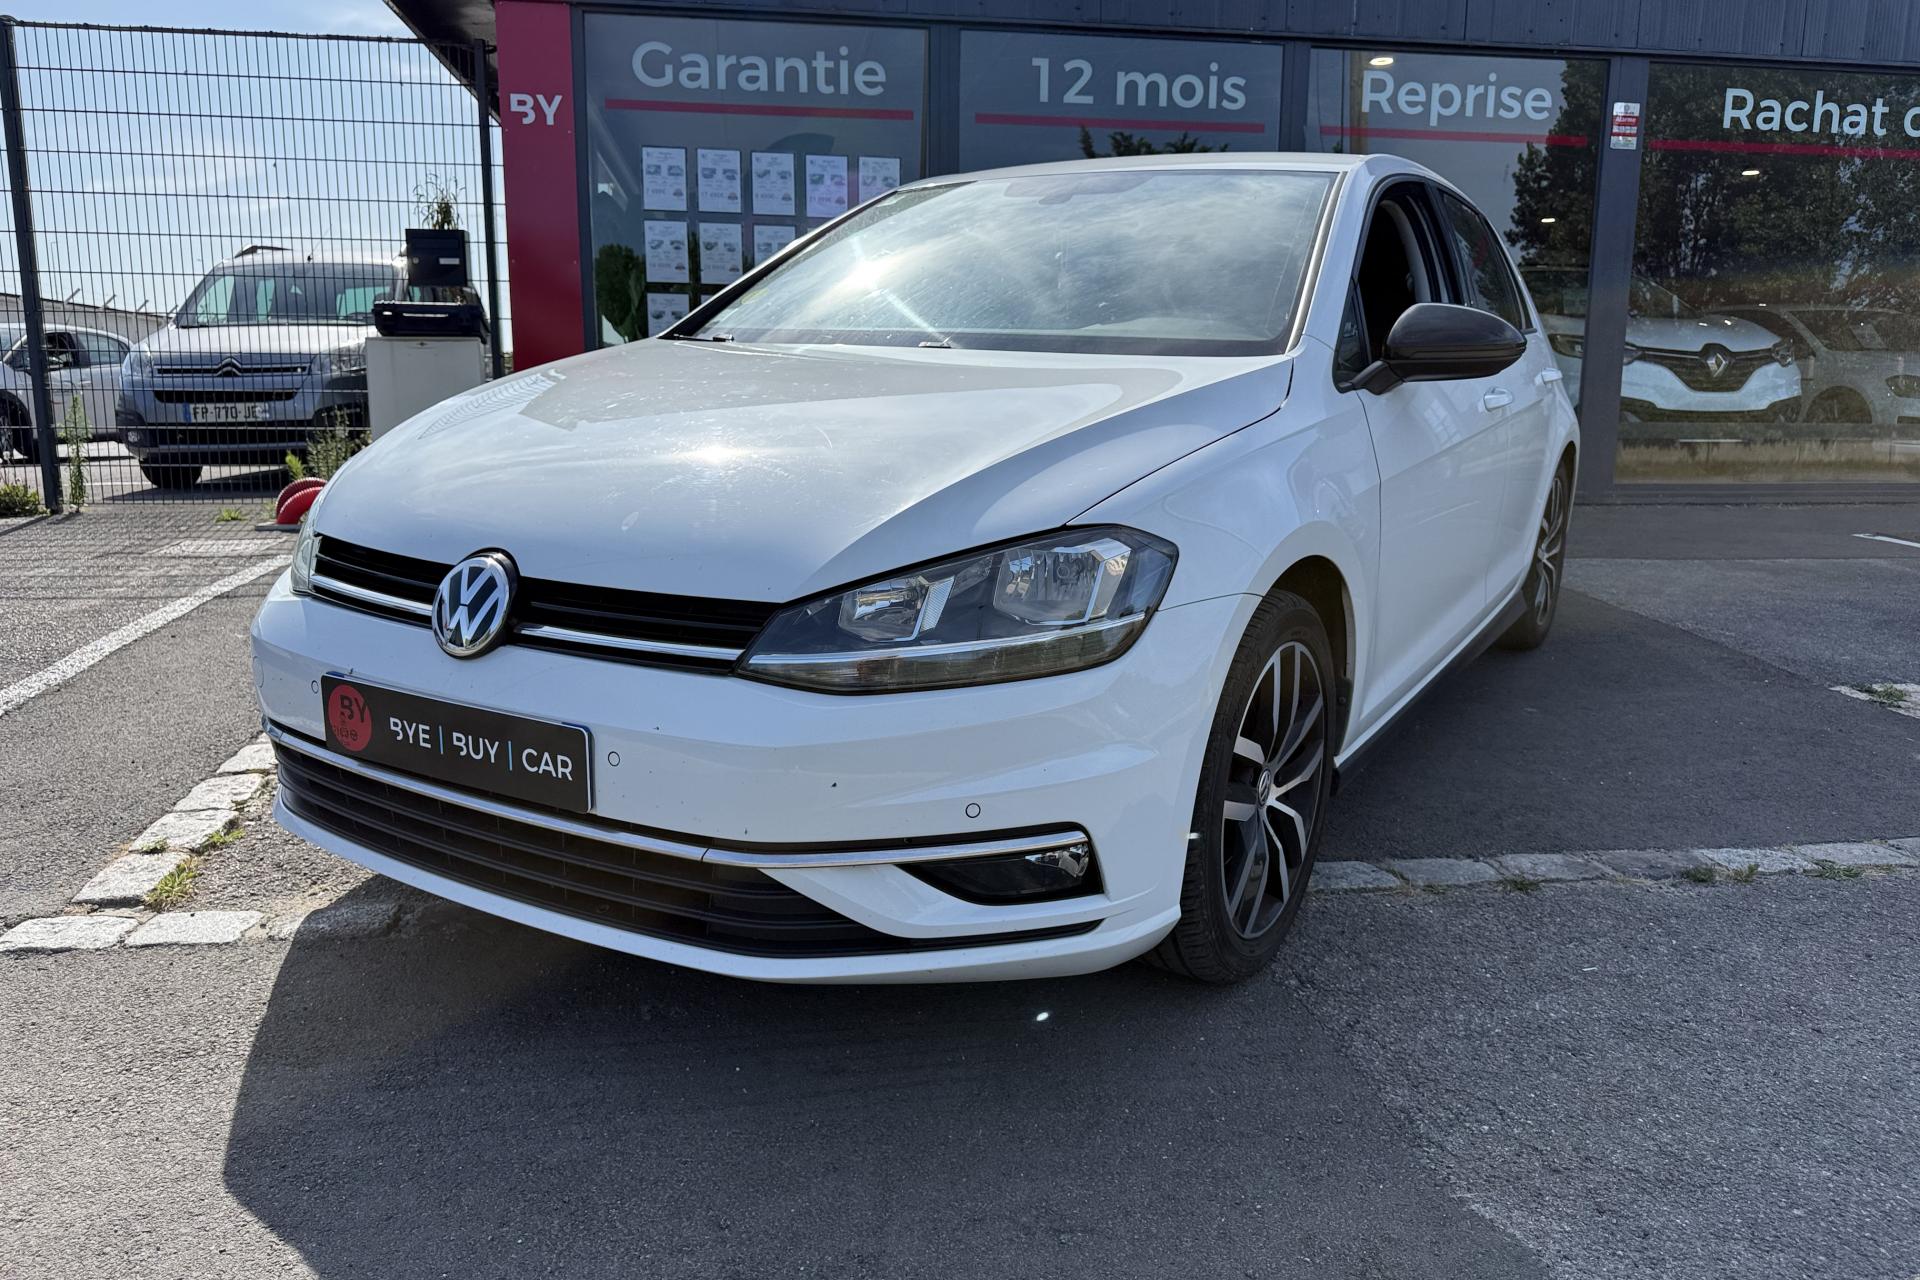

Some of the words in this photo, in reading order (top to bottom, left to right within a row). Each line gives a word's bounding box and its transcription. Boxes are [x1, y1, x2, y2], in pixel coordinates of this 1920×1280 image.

[632, 42, 886, 95] Garantie
[1031, 57, 1094, 105] 12
[1116, 62, 1247, 110] mois
[510, 93, 563, 126] BY
[1361, 70, 1552, 126] Reprise
[1722, 87, 1889, 136] Rachat
[340, 695, 367, 723] BY
[389, 717, 431, 749] BYE
[452, 732, 499, 763] BUY
[522, 748, 573, 781] CAR
